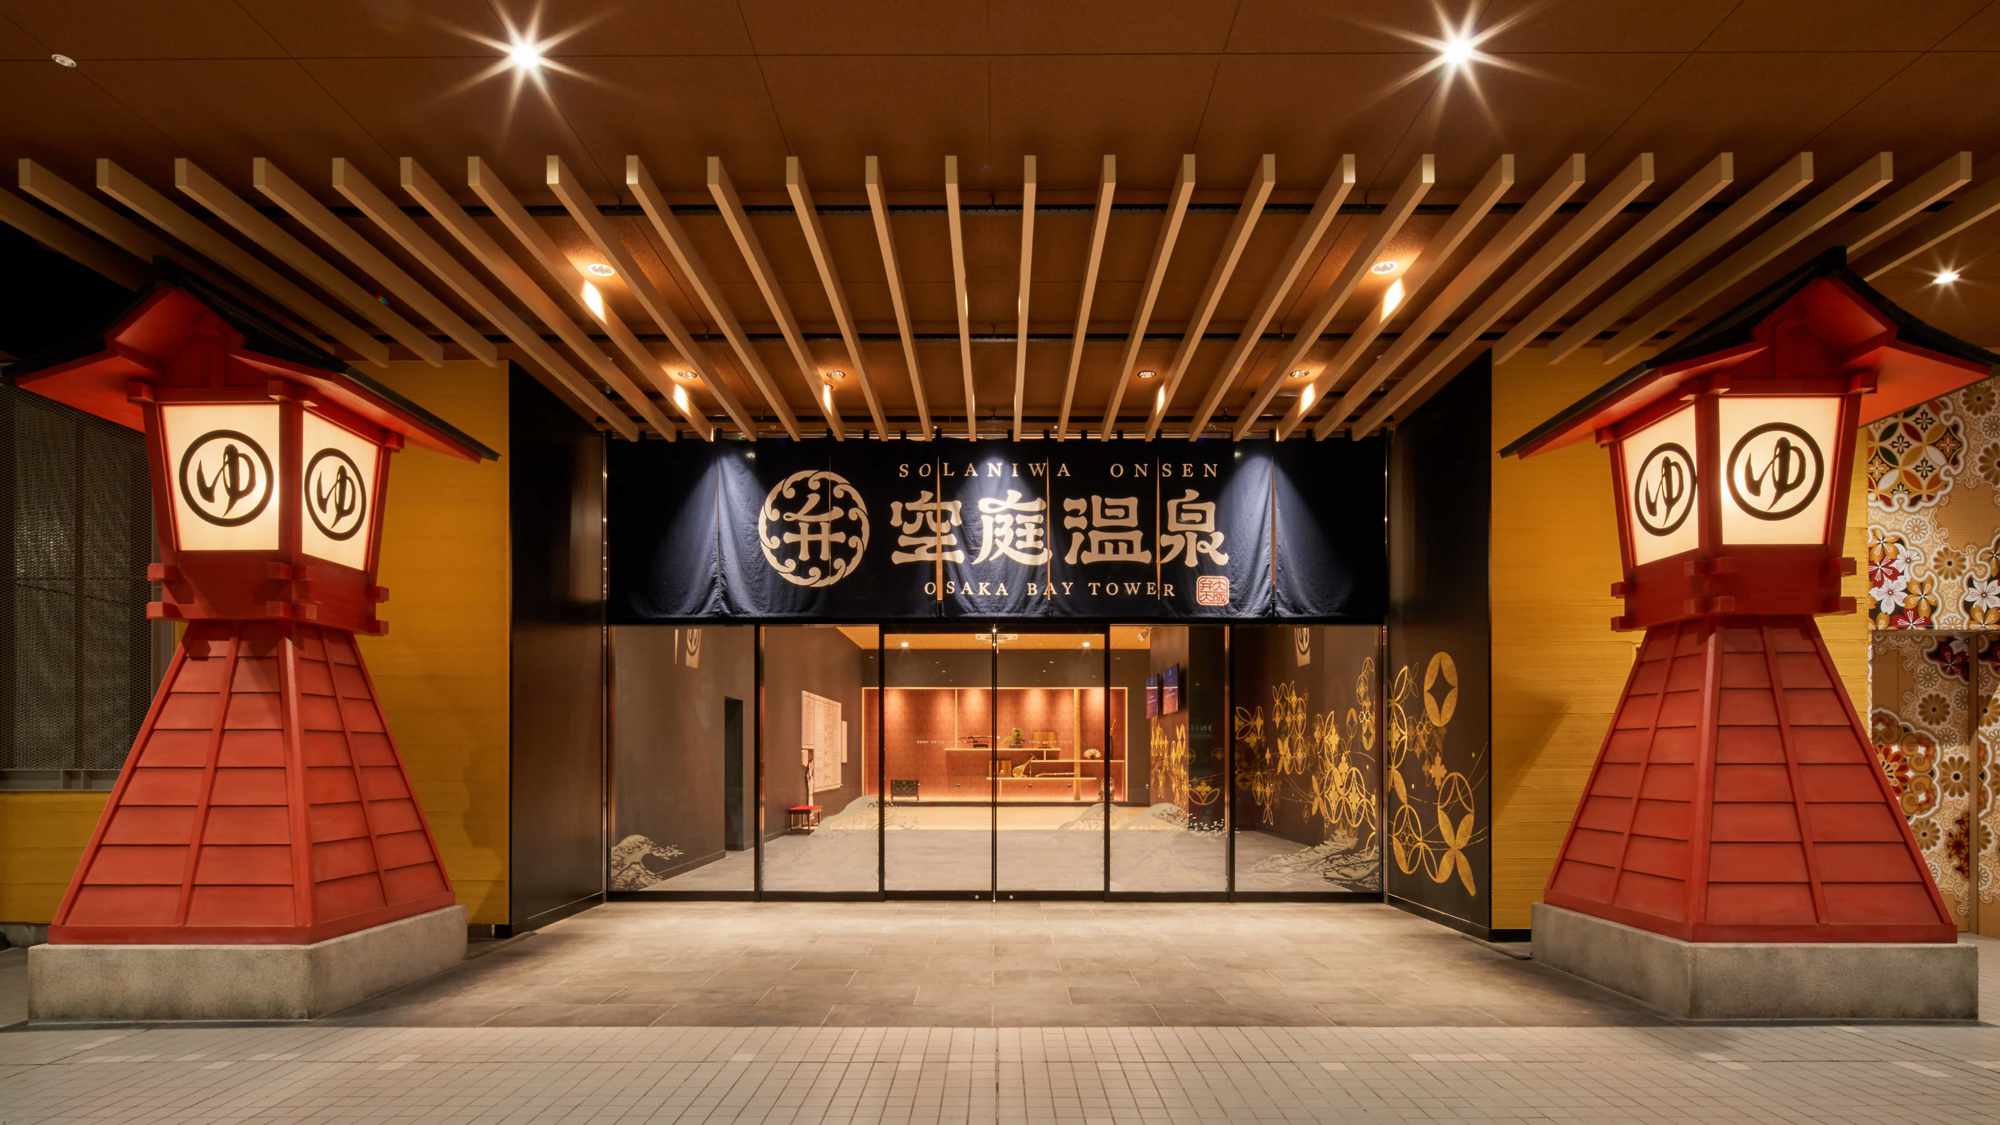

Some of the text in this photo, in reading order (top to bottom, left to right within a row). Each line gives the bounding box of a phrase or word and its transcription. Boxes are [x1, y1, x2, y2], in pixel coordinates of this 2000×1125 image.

[196, 444, 256, 517] ゆ
[317, 465, 356, 529] ゆ
[899, 463, 1218, 477] SOLANIWA ONSEN
[1645, 456, 1684, 527] ゆ
[1745, 437, 1806, 511] ゆ
[890, 489, 1229, 568] 空庭温泉
[924, 582, 1175, 597] OSAKA BAY TOWER
